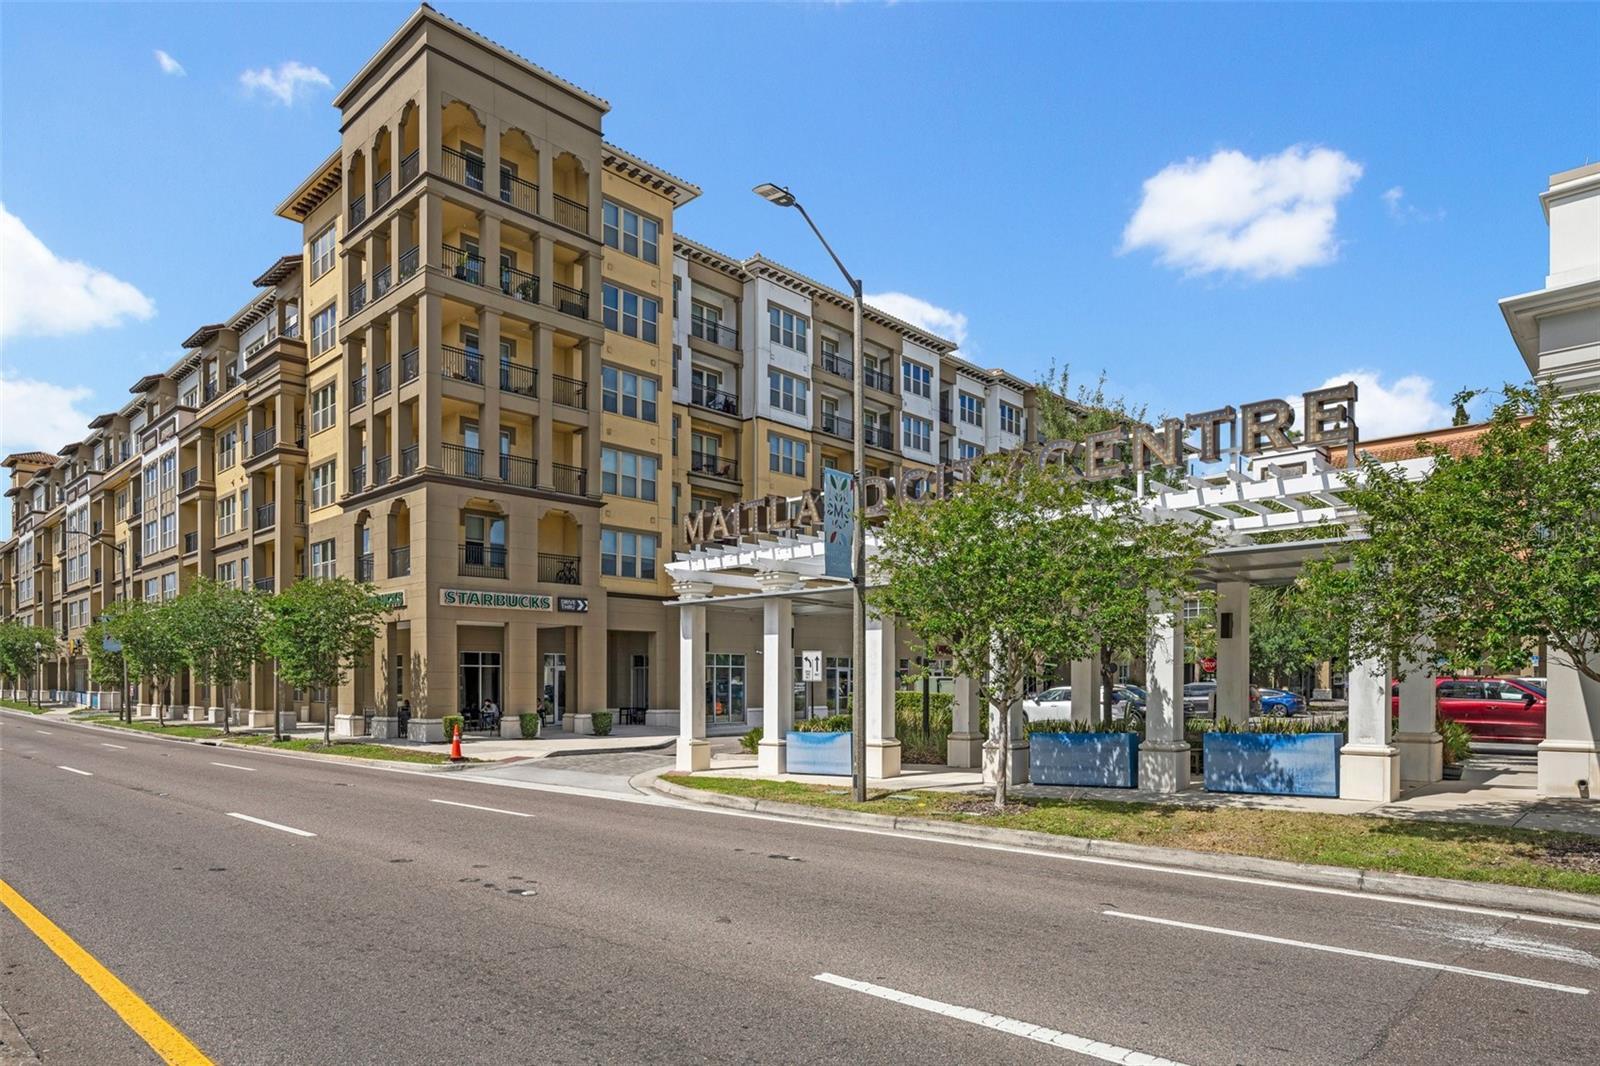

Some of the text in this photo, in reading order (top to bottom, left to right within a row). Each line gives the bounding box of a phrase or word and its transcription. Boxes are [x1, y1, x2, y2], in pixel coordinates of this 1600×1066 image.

[683, 476, 891, 544] MAITLAD
[834, 506, 844, 518] M
[445, 591, 551, 609] STARBUCKS
